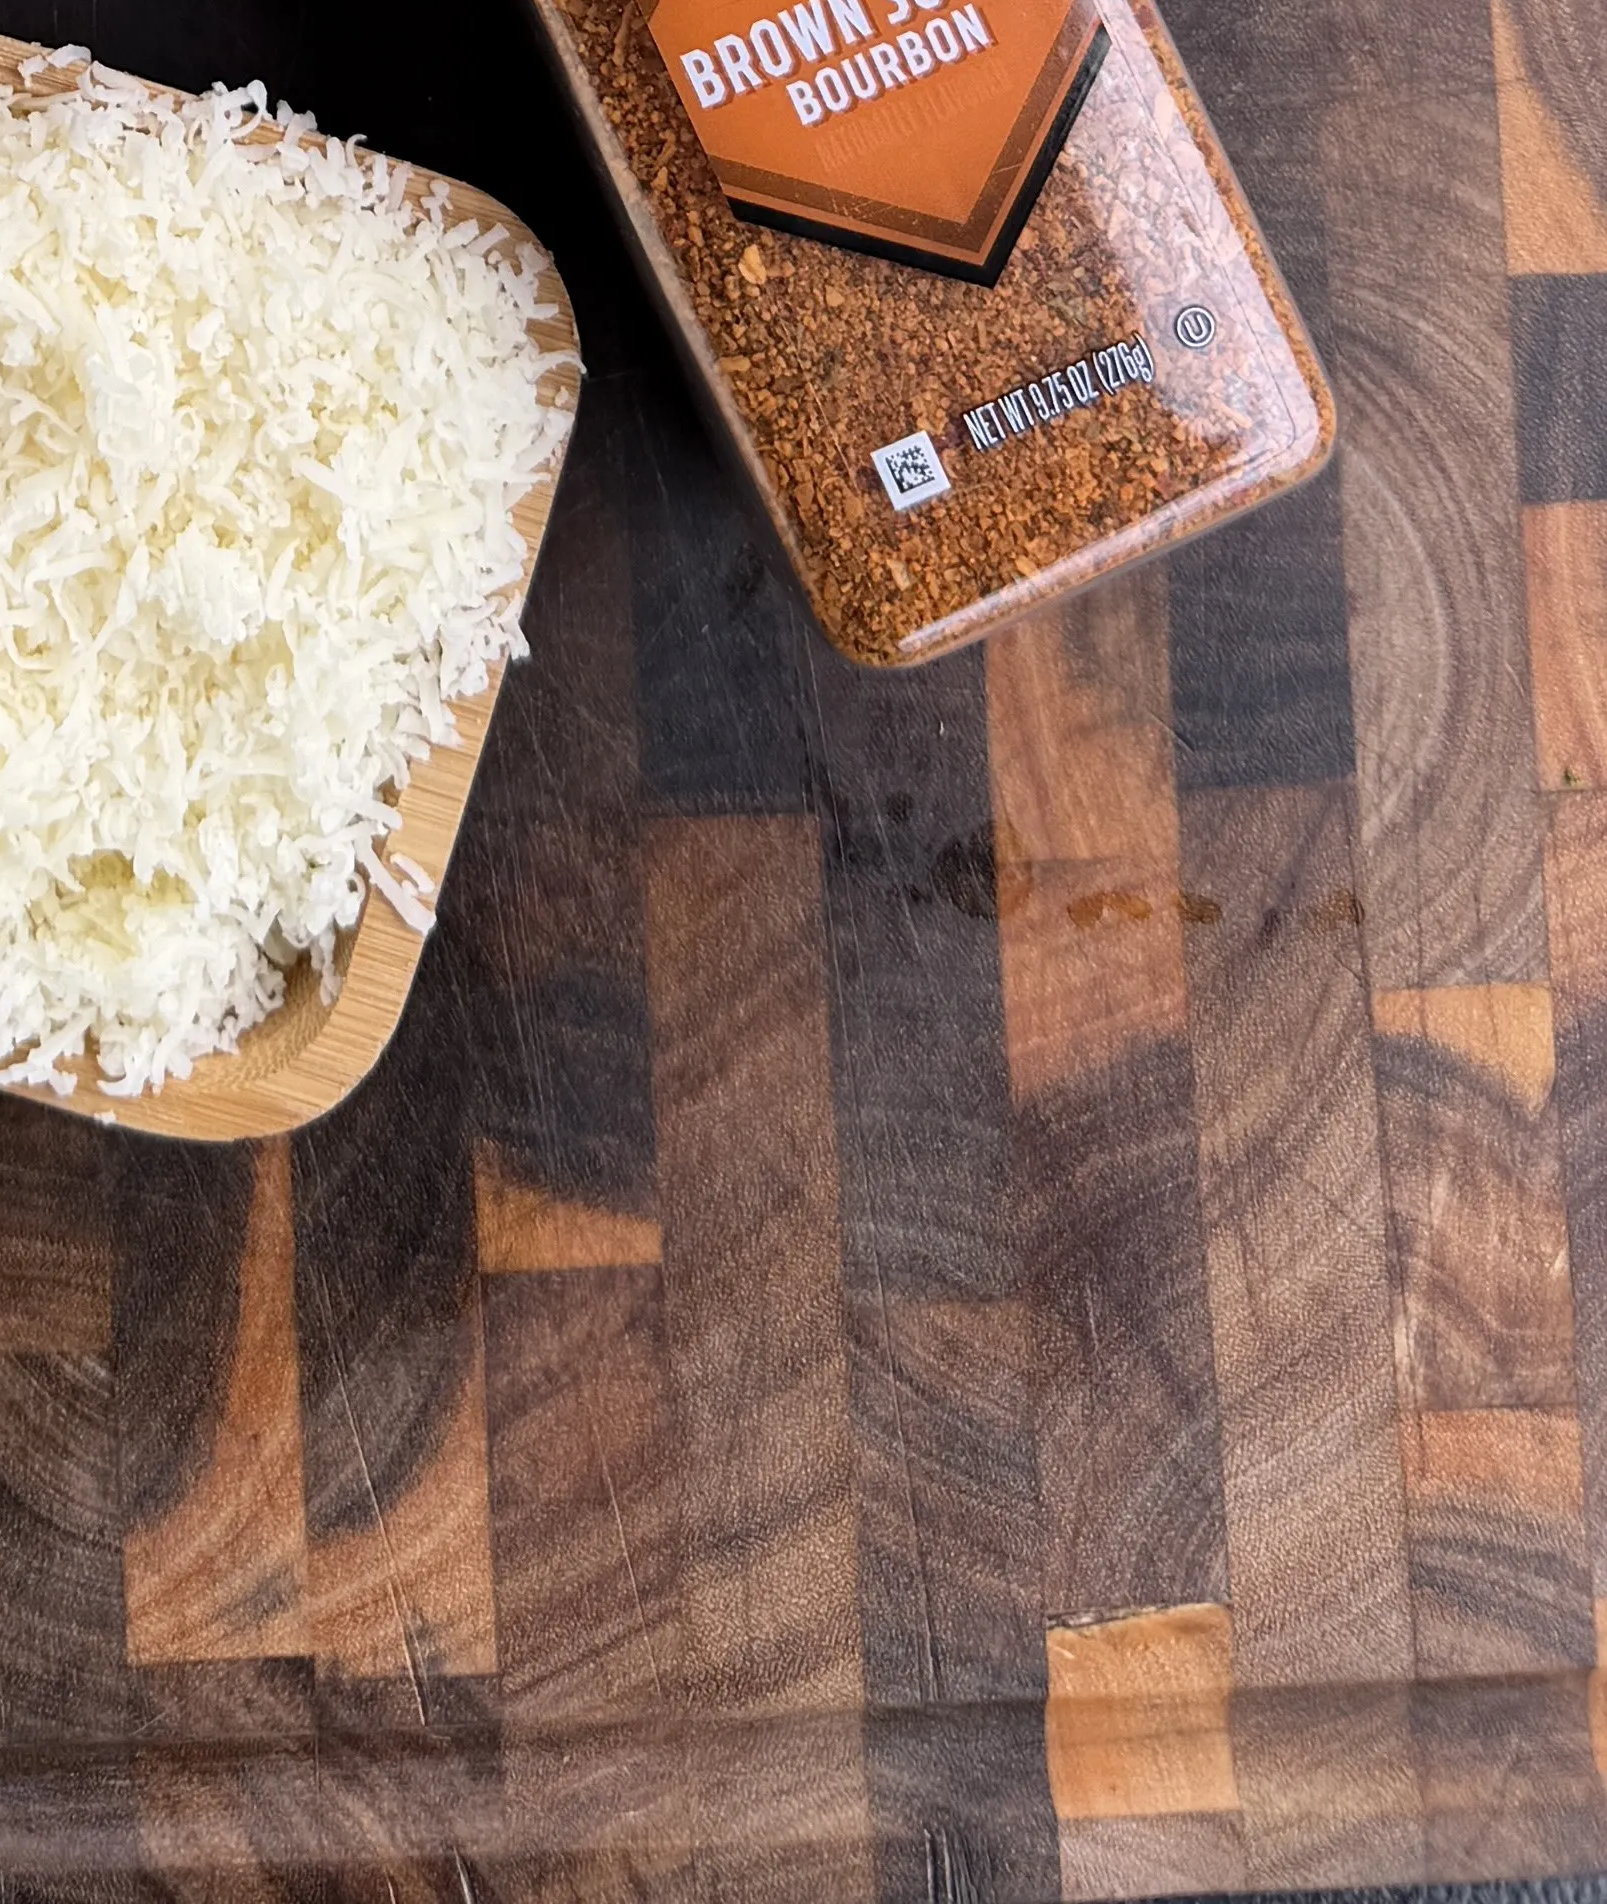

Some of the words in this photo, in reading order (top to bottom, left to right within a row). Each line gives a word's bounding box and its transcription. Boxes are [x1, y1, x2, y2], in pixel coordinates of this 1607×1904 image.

[786, 3, 991, 127] BOURBON
[963, 401, 1006, 451] NET
[999, 388, 1035, 435] WT
[1032, 369, 1075, 422] 9.75
[1067, 358, 1100, 406] OZ
[1092, 332, 1155, 394] (276g)
